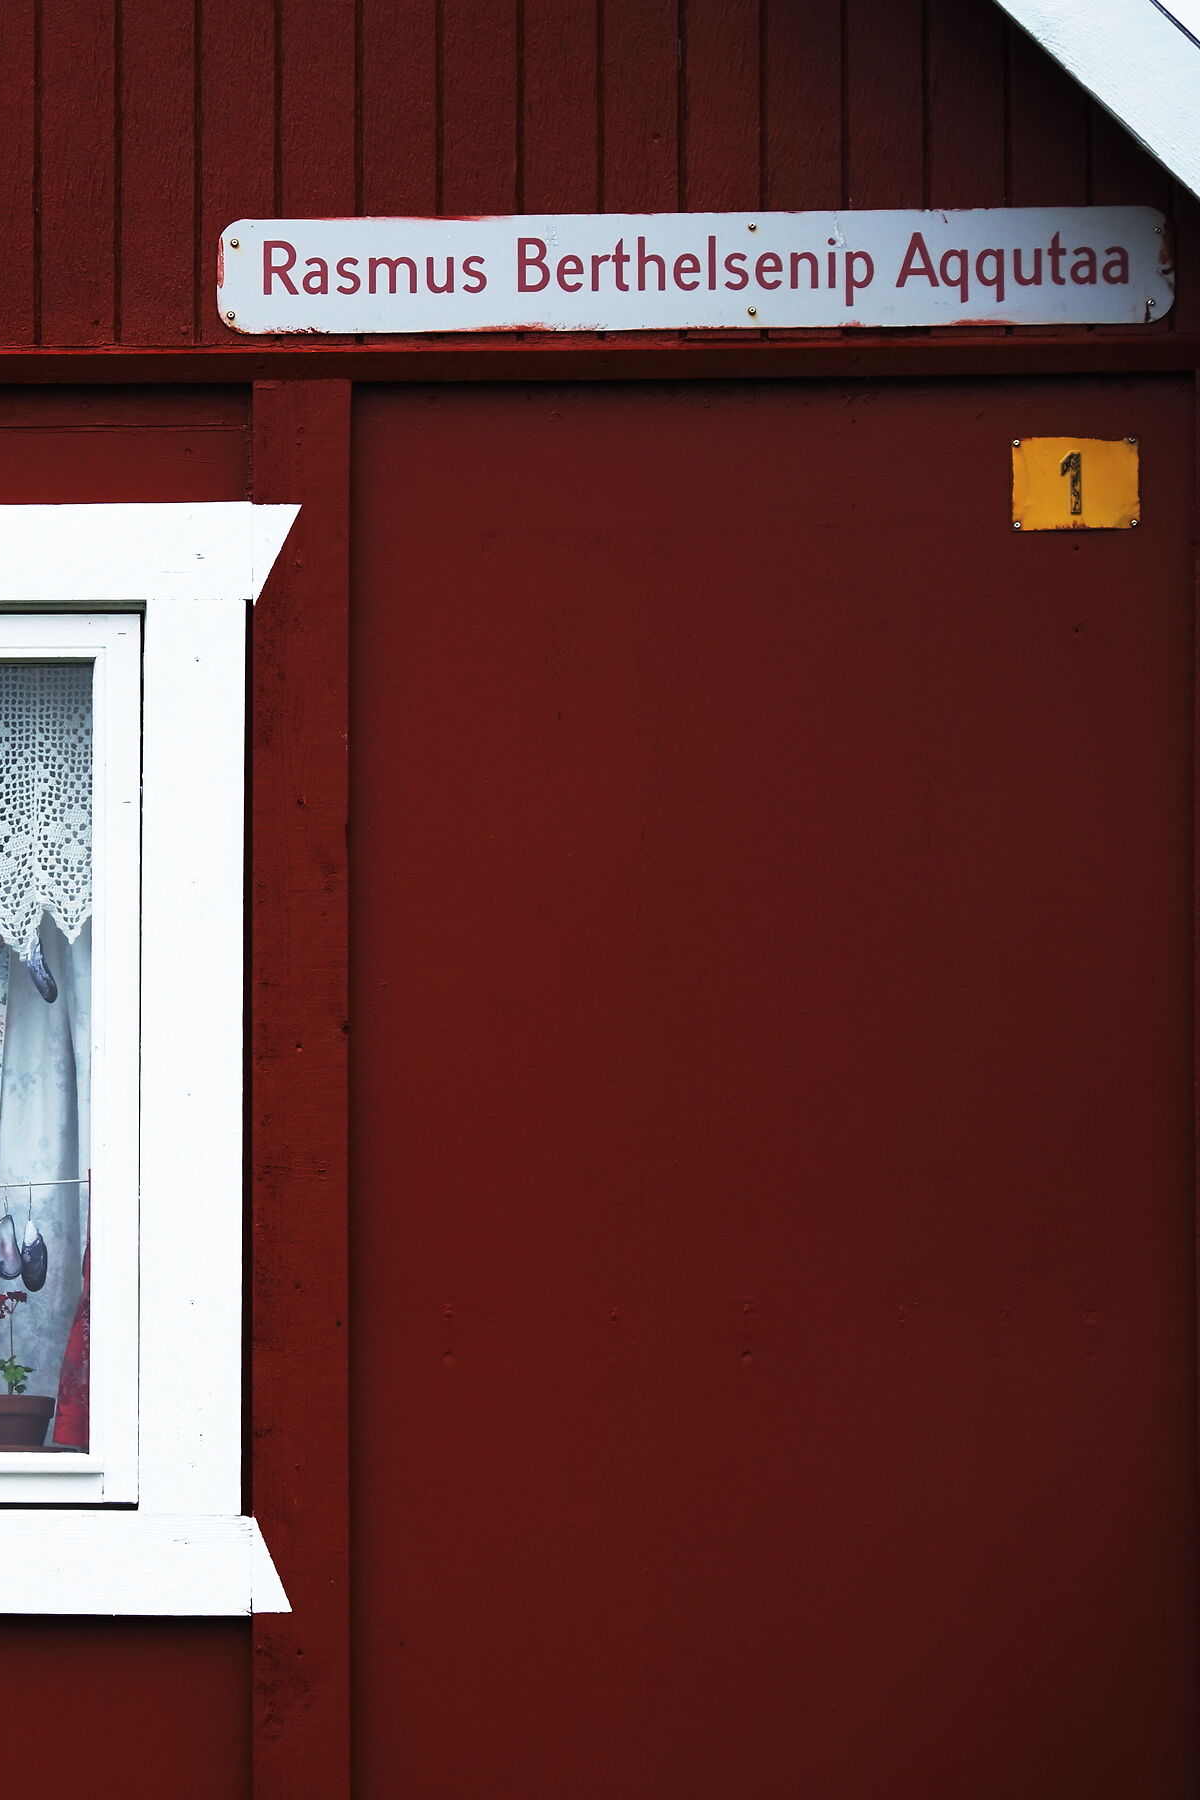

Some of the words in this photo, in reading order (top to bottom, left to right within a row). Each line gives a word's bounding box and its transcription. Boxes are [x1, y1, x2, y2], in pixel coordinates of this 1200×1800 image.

[262, 239, 488, 296] Rasmus
[517, 235, 875, 307] Berthelsenip
[896, 231, 1130, 303] Aqqutaa
[1059, 451, 1082, 515] 1
